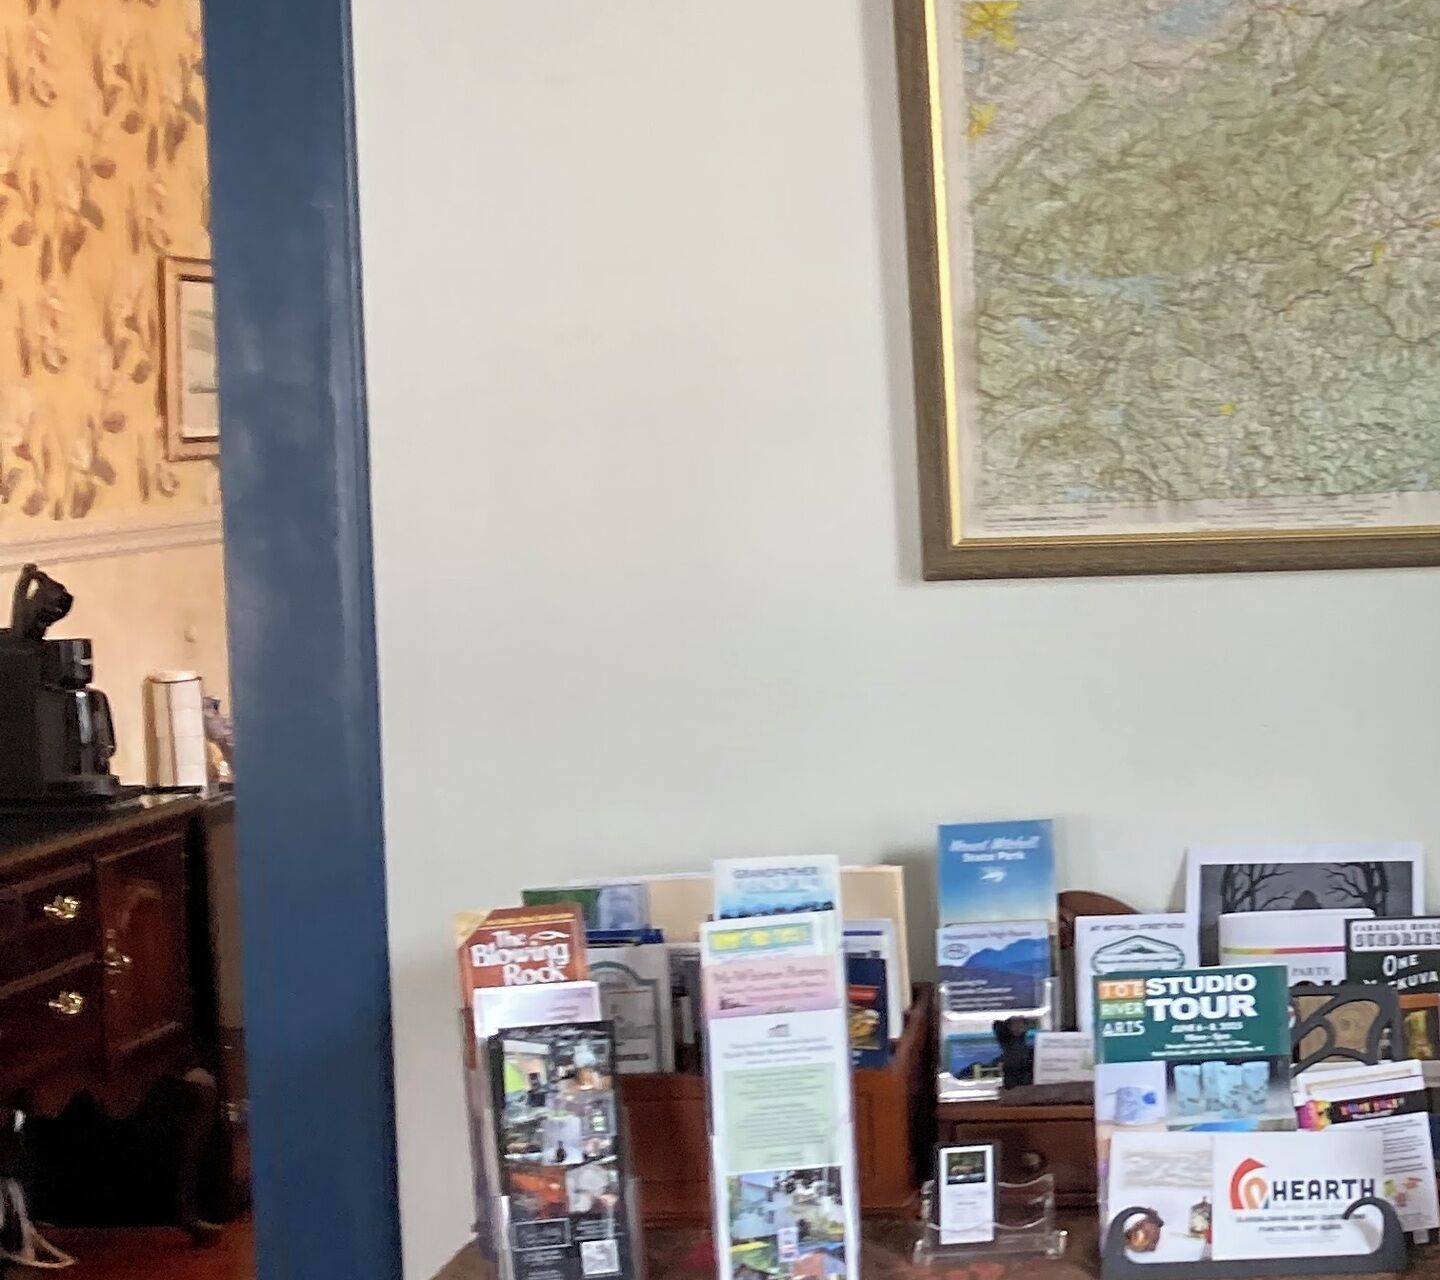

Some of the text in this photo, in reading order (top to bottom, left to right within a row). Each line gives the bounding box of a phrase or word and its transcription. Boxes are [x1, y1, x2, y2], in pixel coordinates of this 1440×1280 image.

[490, 930, 528, 947] The
[469, 942, 571, 970] Blowing
[1382, 954, 1420, 977] ONE
[503, 963, 569, 986] Rock
[1146, 973, 1257, 996] STUDIO
[1099, 981, 1145, 999] TOE
[1100, 1001, 1145, 1017] RIVER
[1145, 995, 1259, 1022] TOUR
[1101, 1020, 1146, 1037] ARTS
[1272, 1178, 1375, 1201] HEARTH
